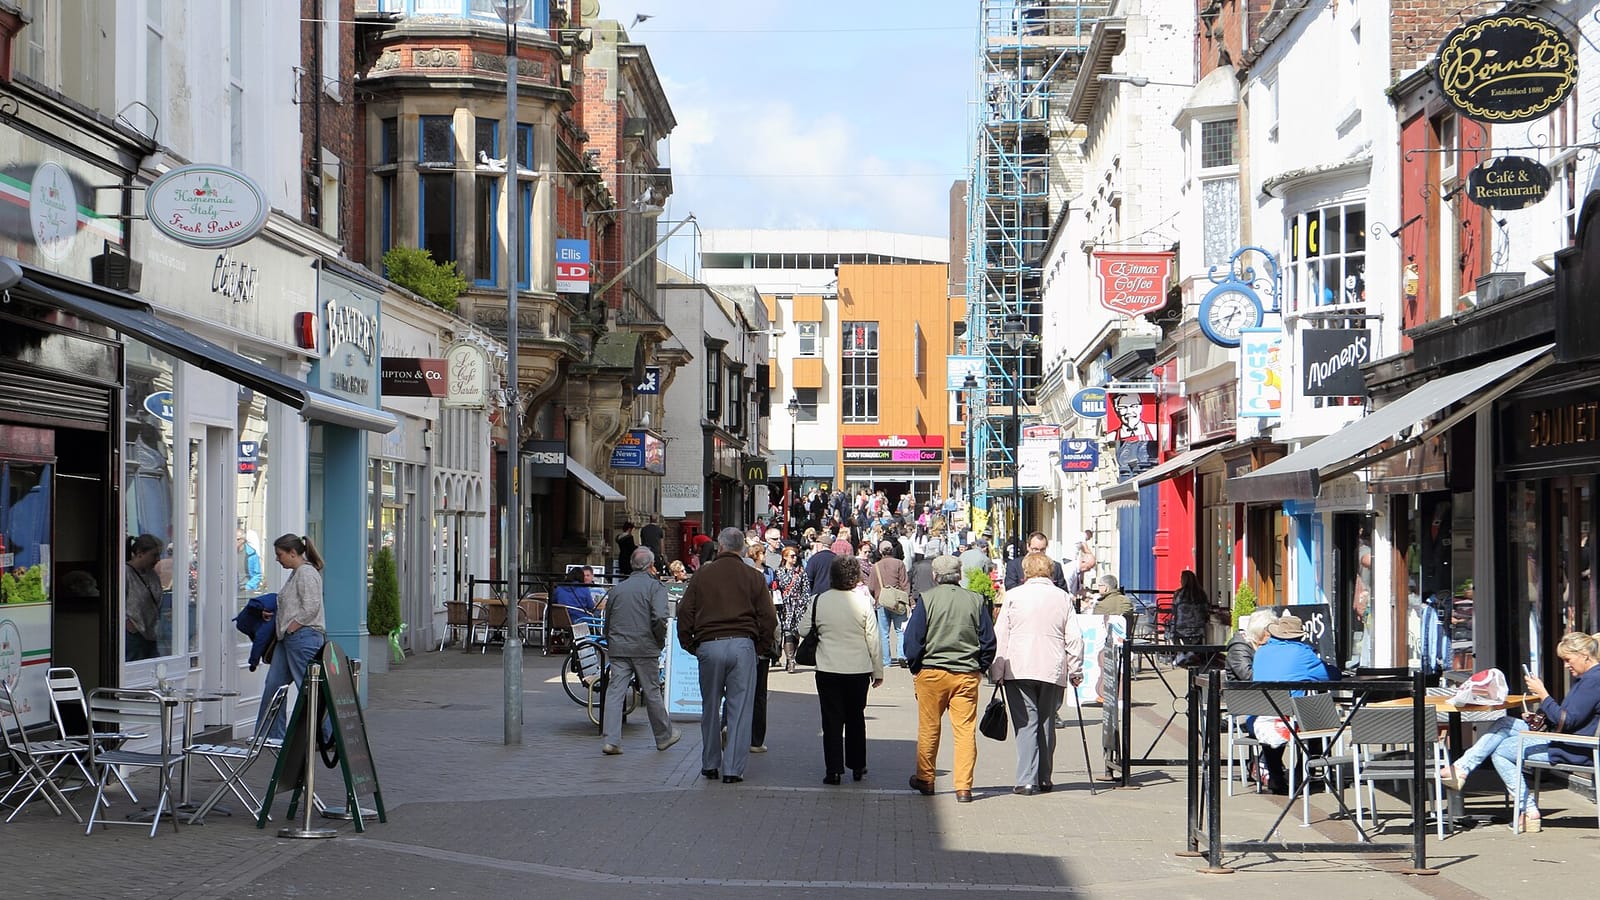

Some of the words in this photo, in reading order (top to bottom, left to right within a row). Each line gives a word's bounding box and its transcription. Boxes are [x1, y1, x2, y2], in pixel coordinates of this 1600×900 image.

[1491, 88, 1527, 96] Established
[1486, 169, 1515, 184] Café
[1518, 170, 1529, 181] &
[174, 189, 233, 204] Homemade
[1476, 184, 1542, 198] Restaurant
[190, 203, 218, 218] Italy
[169, 213, 203, 233] Fresh
[207, 220, 241, 233] Pasta
[561, 248, 581, 260] Ellis
[557, 266, 586, 277] LD
[1114, 276, 1153, 292] Coffee
[1110, 291, 1157, 307] Lounge
[326, 298, 378, 366] BAXTERS
[1307, 336, 1368, 389] Moments
[414, 370, 423, 379] &
[1247, 343, 1268, 410] MUSIC
[1082, 401, 1106, 412] HILL
[878, 435, 908, 447] wilko
